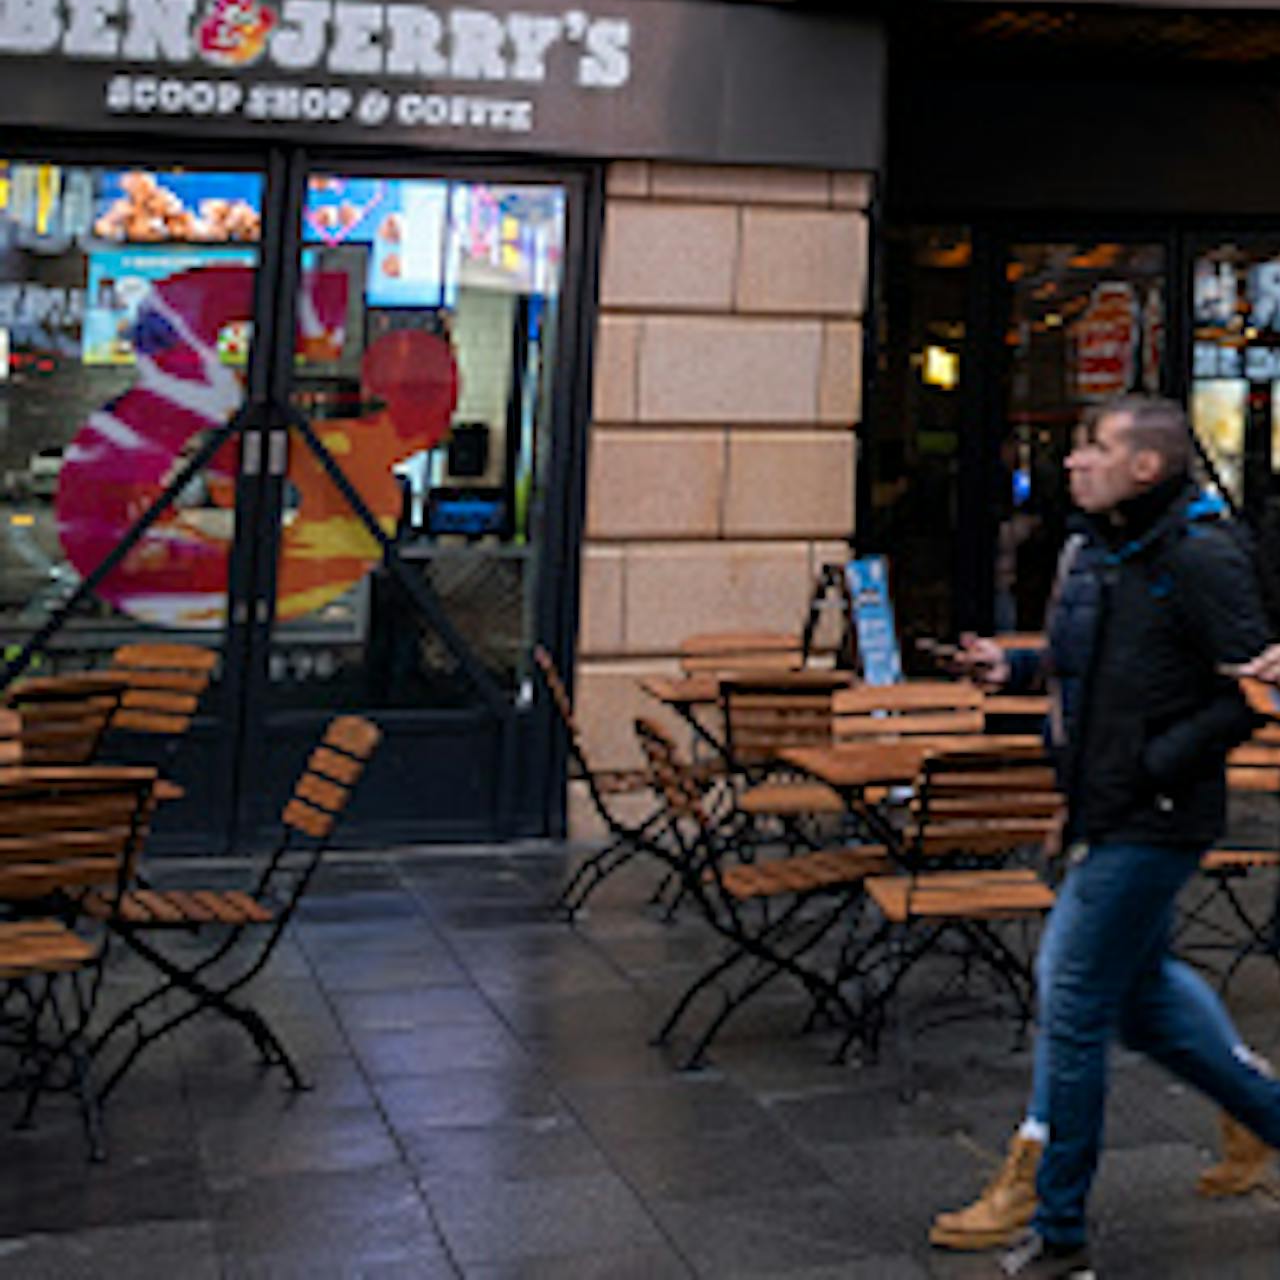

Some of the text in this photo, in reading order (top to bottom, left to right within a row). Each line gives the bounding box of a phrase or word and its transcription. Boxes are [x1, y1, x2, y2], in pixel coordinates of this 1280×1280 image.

[106, 73, 243, 114] SCOOP
[245, 84, 350, 120] SHOP
[397, 93, 533, 132] COFFEE
